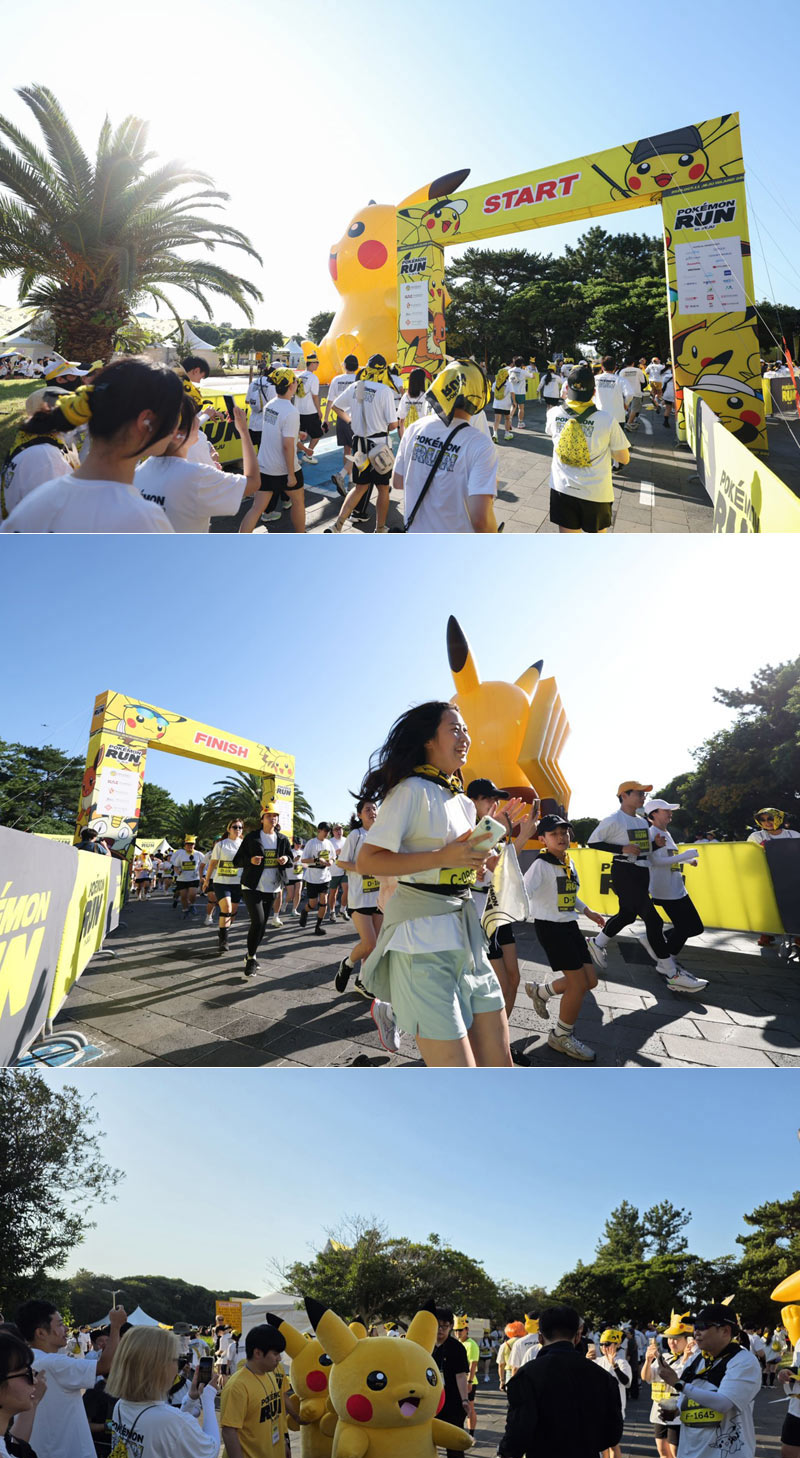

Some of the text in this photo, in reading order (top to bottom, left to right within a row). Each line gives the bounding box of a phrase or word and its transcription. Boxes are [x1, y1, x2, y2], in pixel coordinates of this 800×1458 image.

[483, 173, 580, 214] START
[677, 199, 736, 216] POKÉMON
[674, 207, 736, 230] RUN
[400, 261, 426, 274] RUN
[555, 416, 595, 426] POKON
[194, 731, 249, 759] FINISH
[105, 748, 142, 763] RUN
[276, 787, 292, 797] RUN
